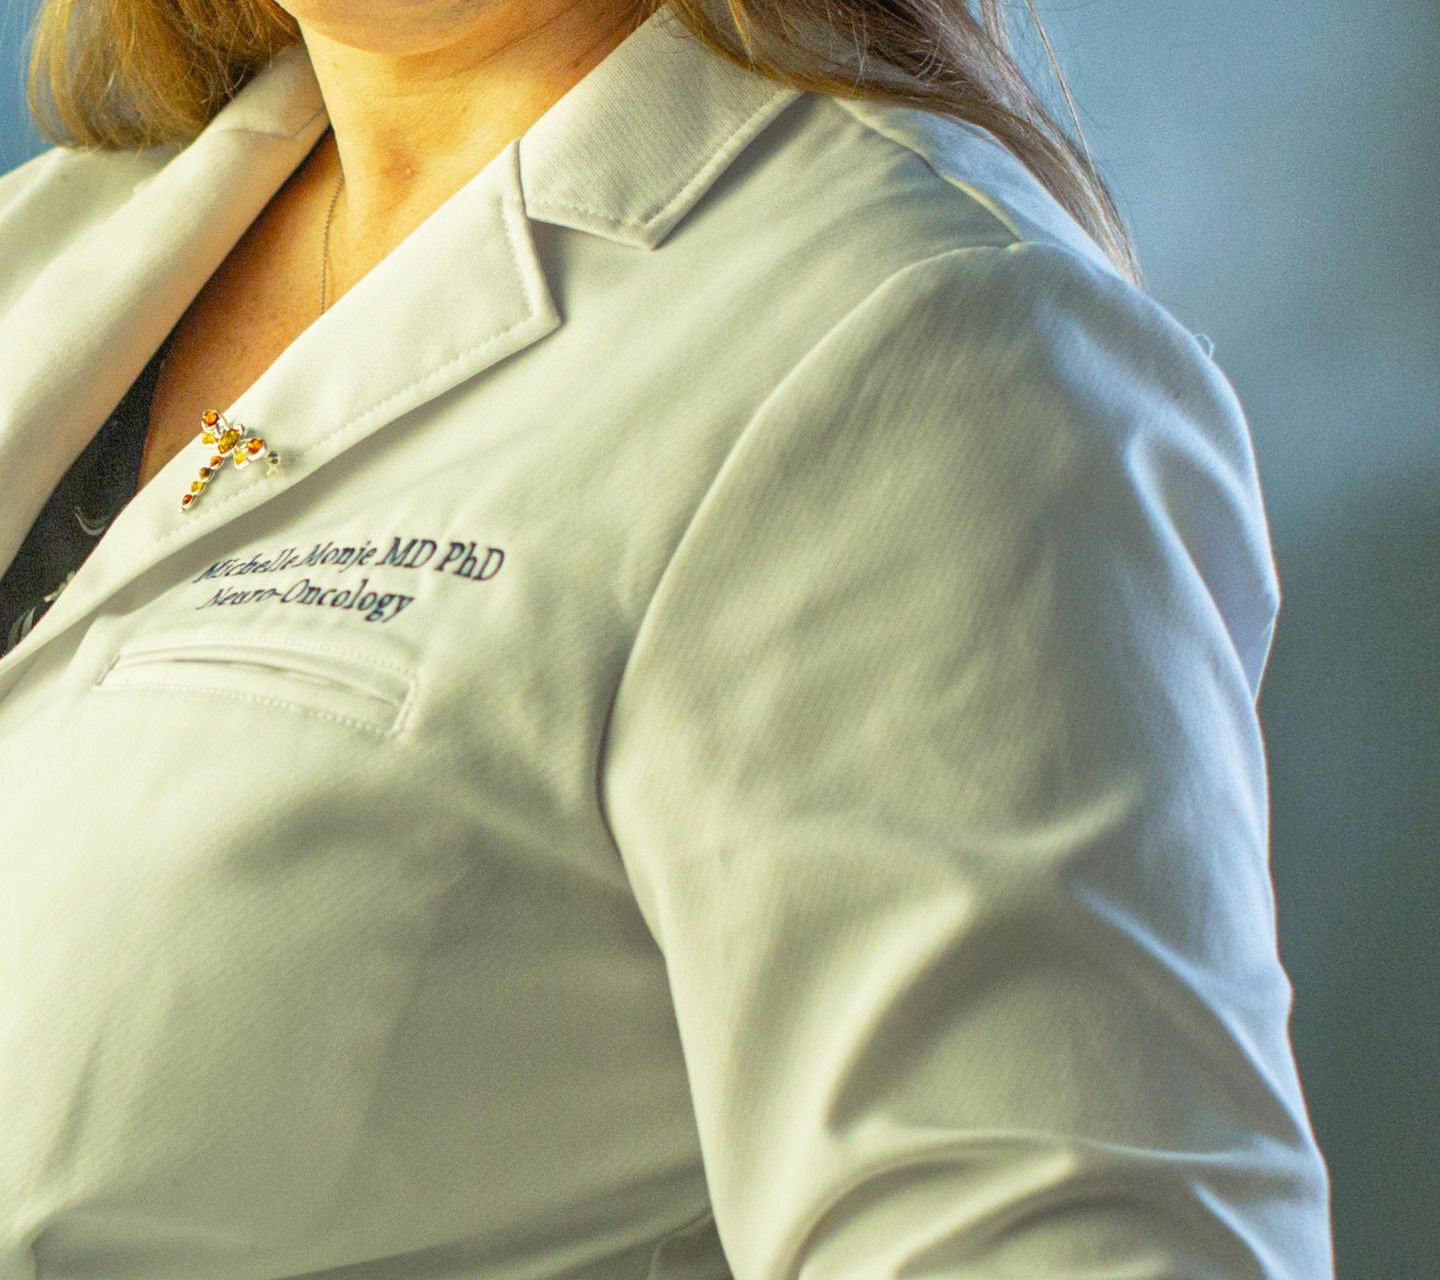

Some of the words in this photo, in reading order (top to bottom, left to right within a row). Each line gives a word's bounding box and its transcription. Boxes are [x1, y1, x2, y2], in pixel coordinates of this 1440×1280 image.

[192, 547, 300, 584] Michelle
[291, 539, 378, 574] Monje
[375, 536, 438, 568] MD
[434, 539, 506, 581] PhD
[195, 578, 416, 623] Neuro-Oncology
